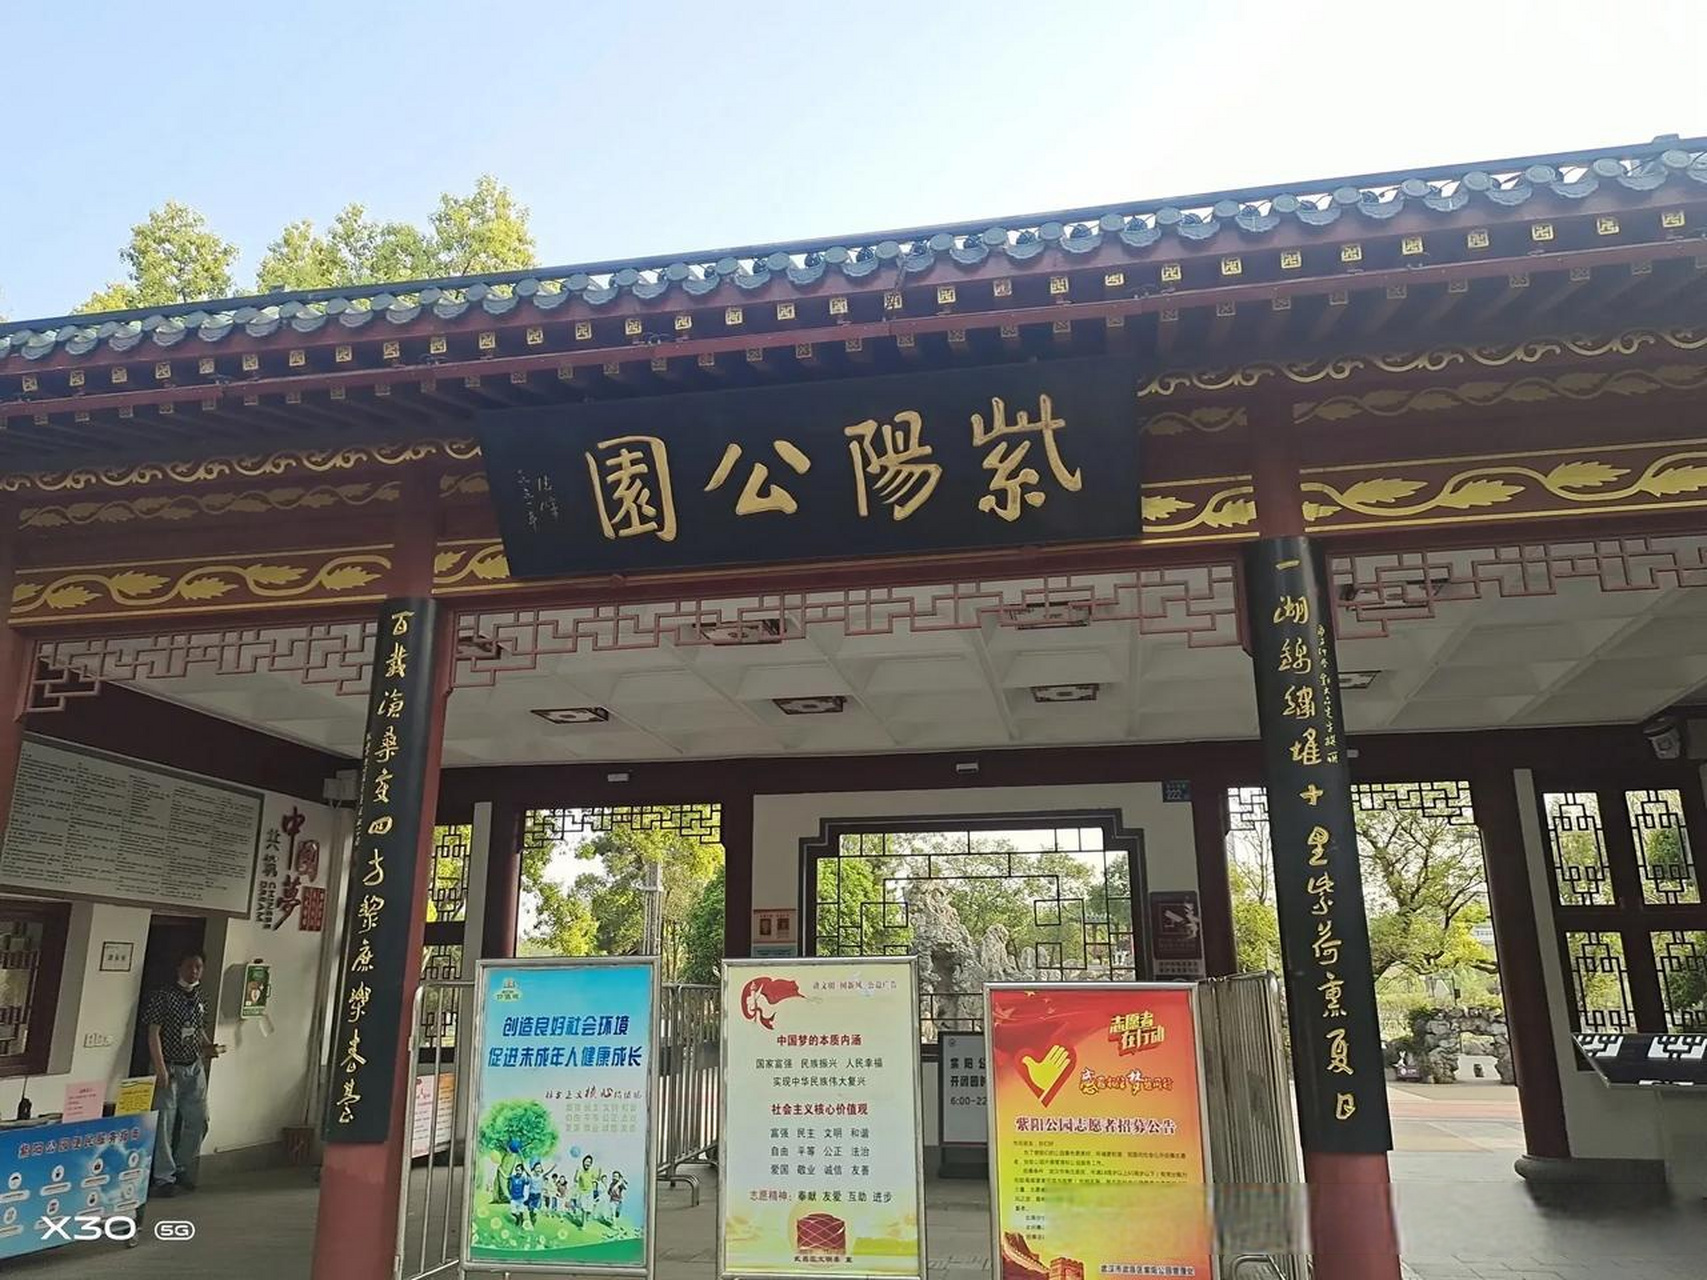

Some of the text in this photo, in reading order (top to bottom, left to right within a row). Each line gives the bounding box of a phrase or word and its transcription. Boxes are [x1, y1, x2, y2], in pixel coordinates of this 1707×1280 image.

[502, 1015, 631, 1037] 创造良好社会环境
[776, 1034, 862, 1047] 中国梦的本质内涵
[488, 1046, 643, 1068] 促进未成年人健康成长
[755, 1057, 883, 1069] 国家富强 民族振兴 人民幸福
[773, 1076, 866, 1087] 实现中华民族伟大复兴
[771, 1103, 868, 1116] 社会主义核心价值观
[1015, 1115, 1176, 1135] 紫阳公园志愿者招募公告
[770, 1128, 869, 1139] 富强 民主 文明 和谐
[770, 1146, 869, 1157] 自由 平等 公正 法治
[770, 1164, 869, 1176] 爱国 敬业 诚信 友善
[798, 1191, 816, 1202] 奉献
[822, 1191, 842, 1202] 友爱
[848, 1191, 867, 1202] 互助
[873, 1191, 892, 1203] 进步
